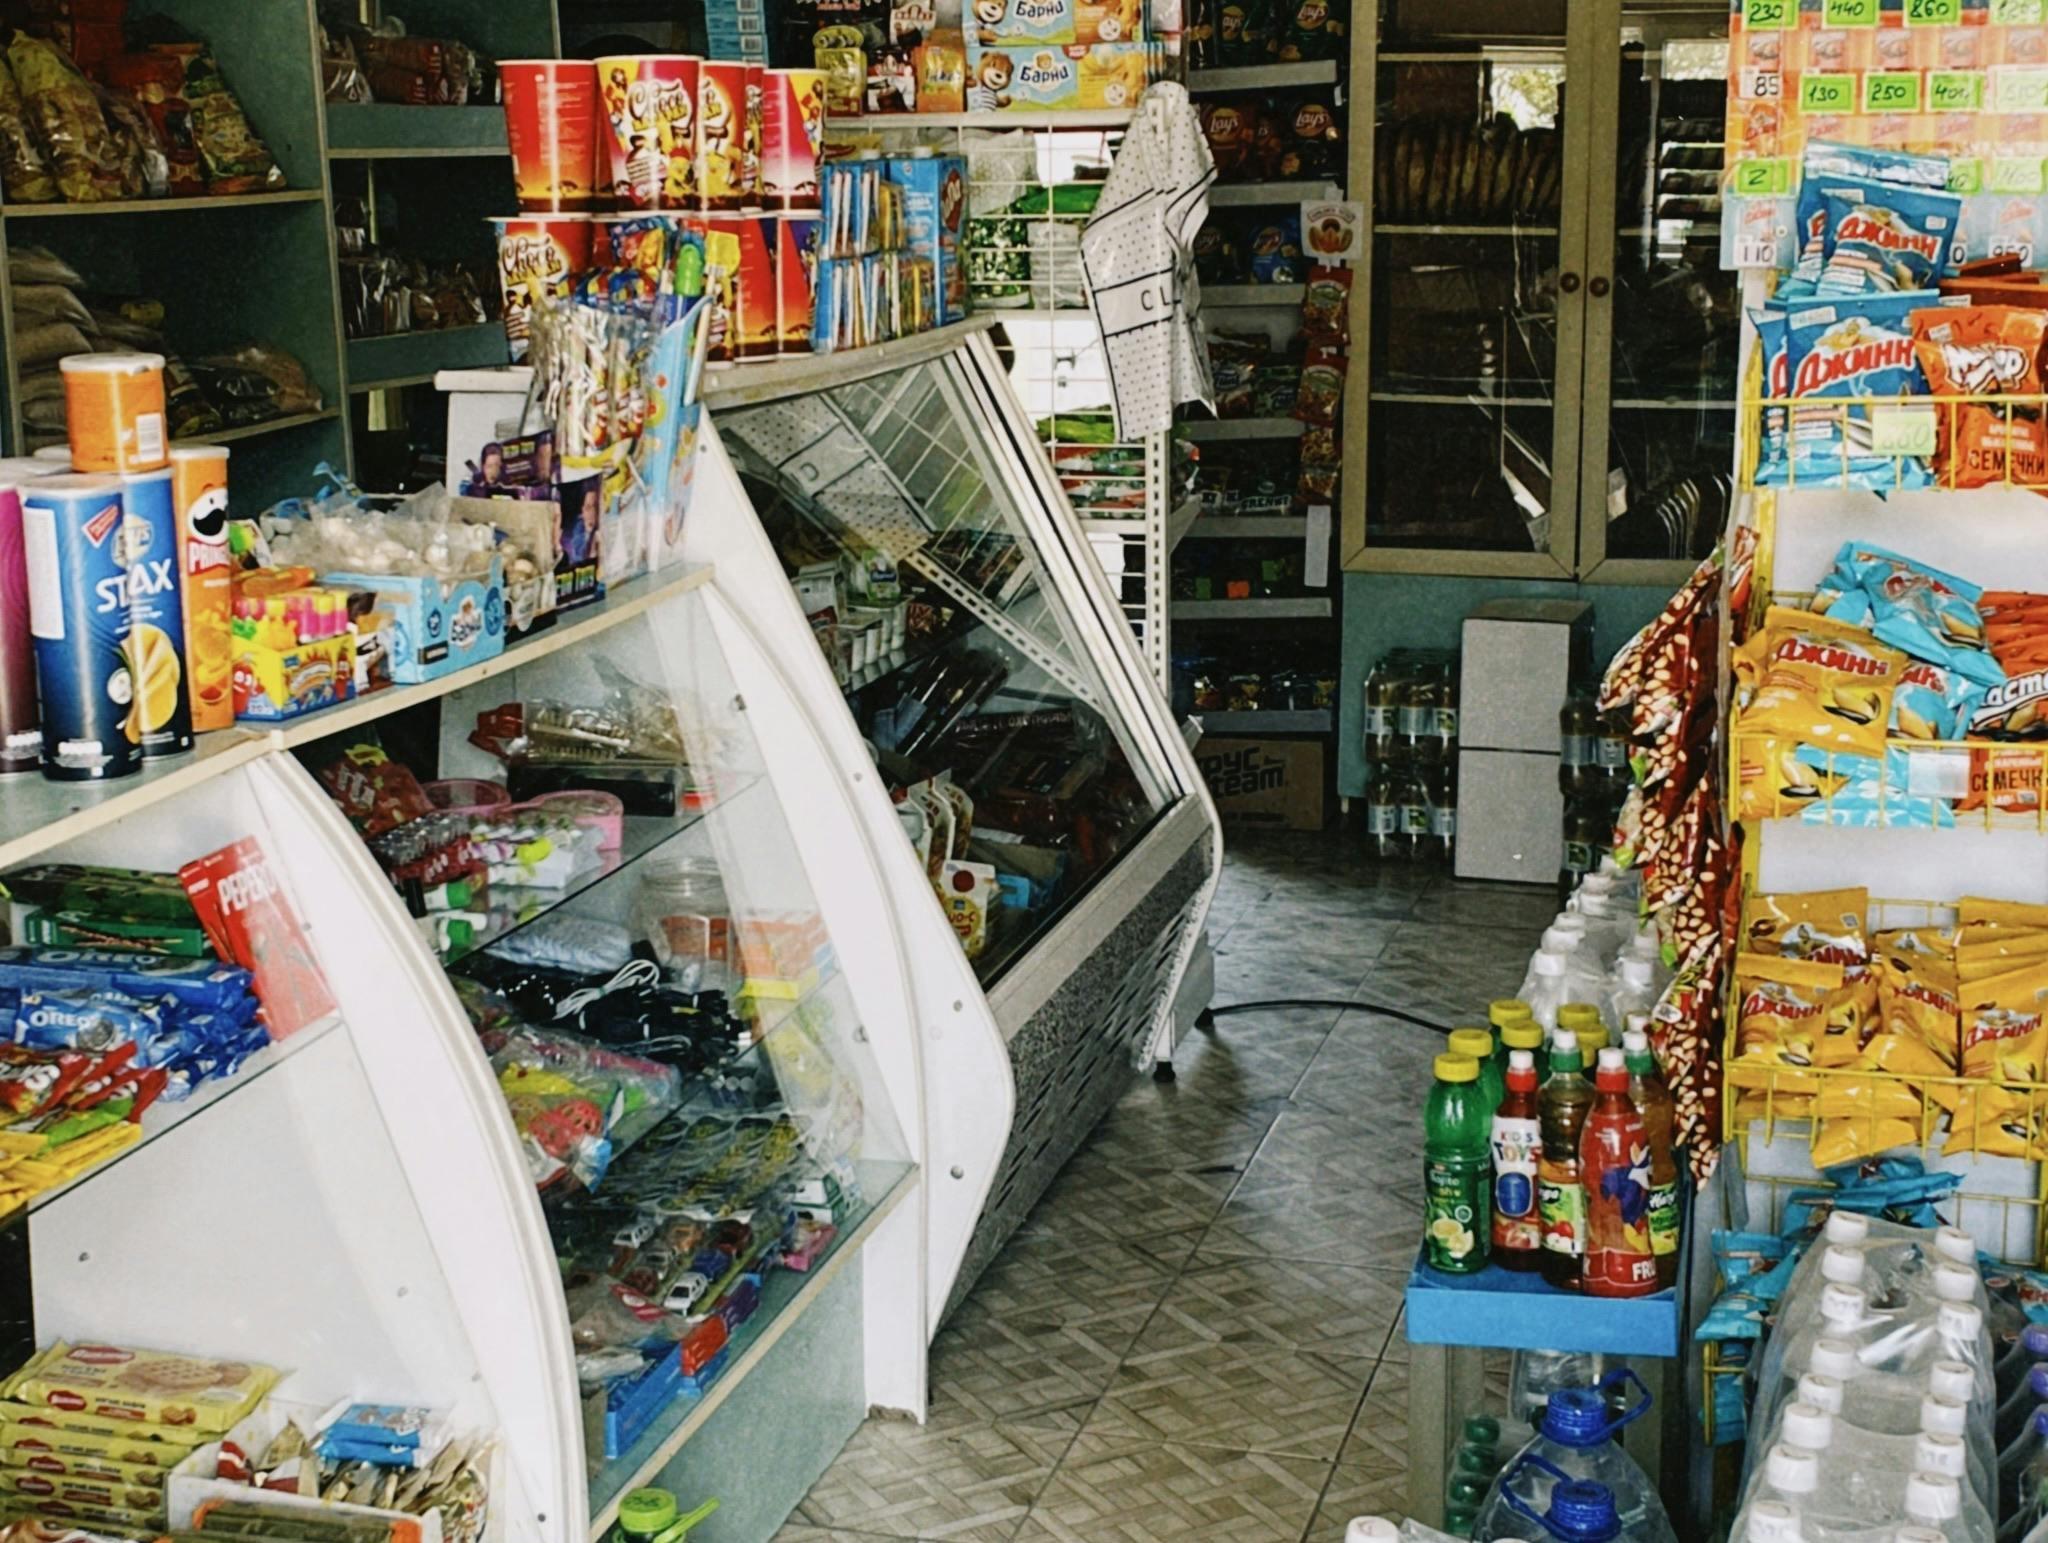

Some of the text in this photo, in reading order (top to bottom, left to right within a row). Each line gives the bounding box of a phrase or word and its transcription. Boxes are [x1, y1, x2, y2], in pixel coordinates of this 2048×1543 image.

[1015, 0, 1064, 18] Барни
[1748, 3, 1783, 24] 230
[1830, 1, 1865, 17] 440
[1020, 66, 1070, 83] Барни
[1755, 75, 1779, 97] 85
[1808, 85, 1839, 102] 130
[1871, 85, 1906, 101] 250
[1744, 245, 1774, 262] 110
[1795, 338, 1915, 398] ДЖИНН
[1776, 637, 1889, 676] ДЖИНН
[1972, 768, 2048, 792] СЕМЕЧК
[1743, 993, 1824, 1018] ДЖИНН
[1964, 1014, 2043, 1049] ДЖИНН
